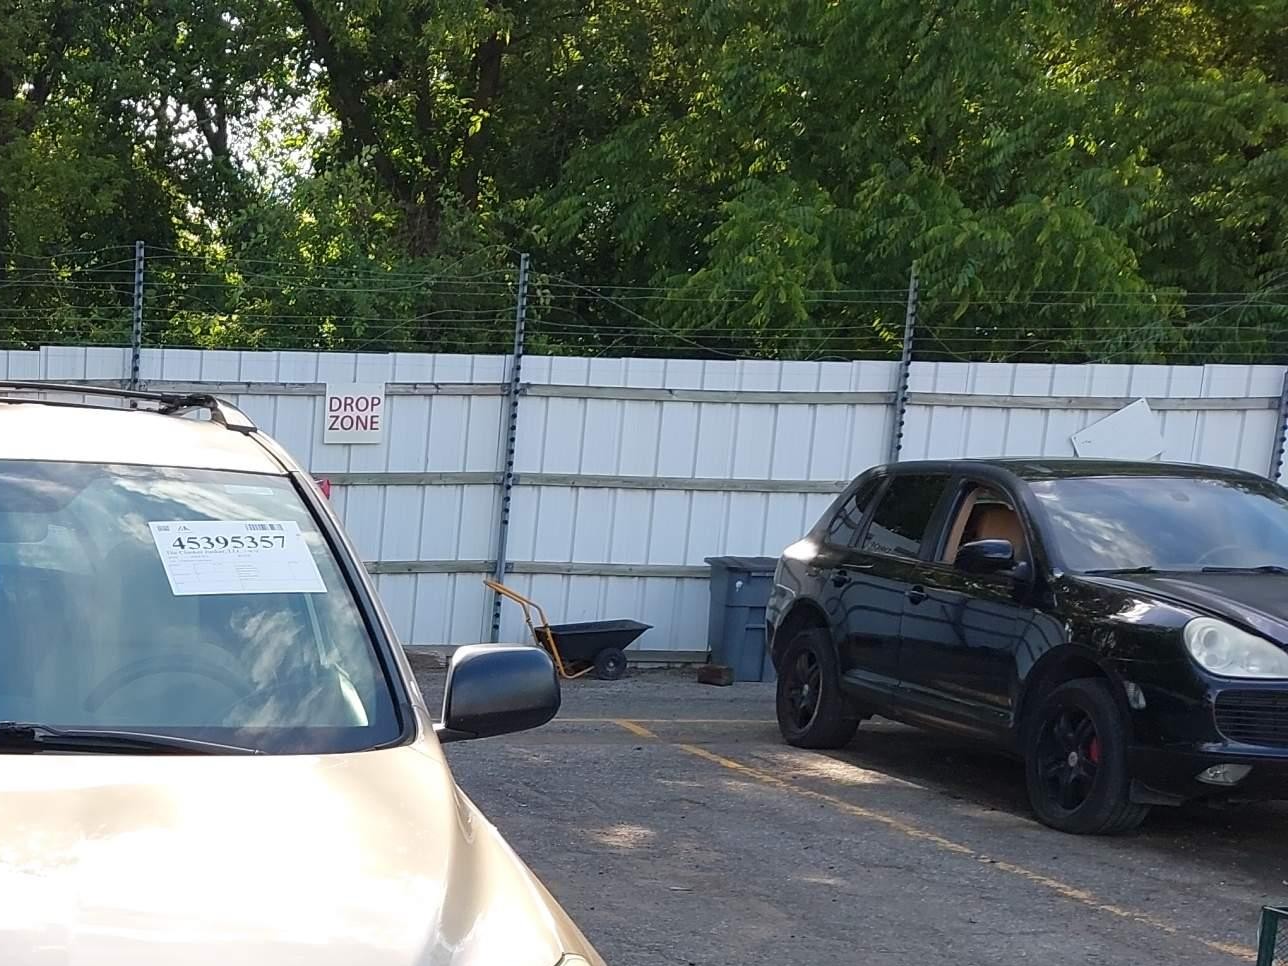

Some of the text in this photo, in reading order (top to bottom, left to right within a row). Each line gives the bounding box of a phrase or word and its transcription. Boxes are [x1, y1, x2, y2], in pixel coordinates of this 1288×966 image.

[329, 396, 381, 412] DROP
[328, 415, 379, 431] ZONE
[172, 535, 285, 549] 45395357
